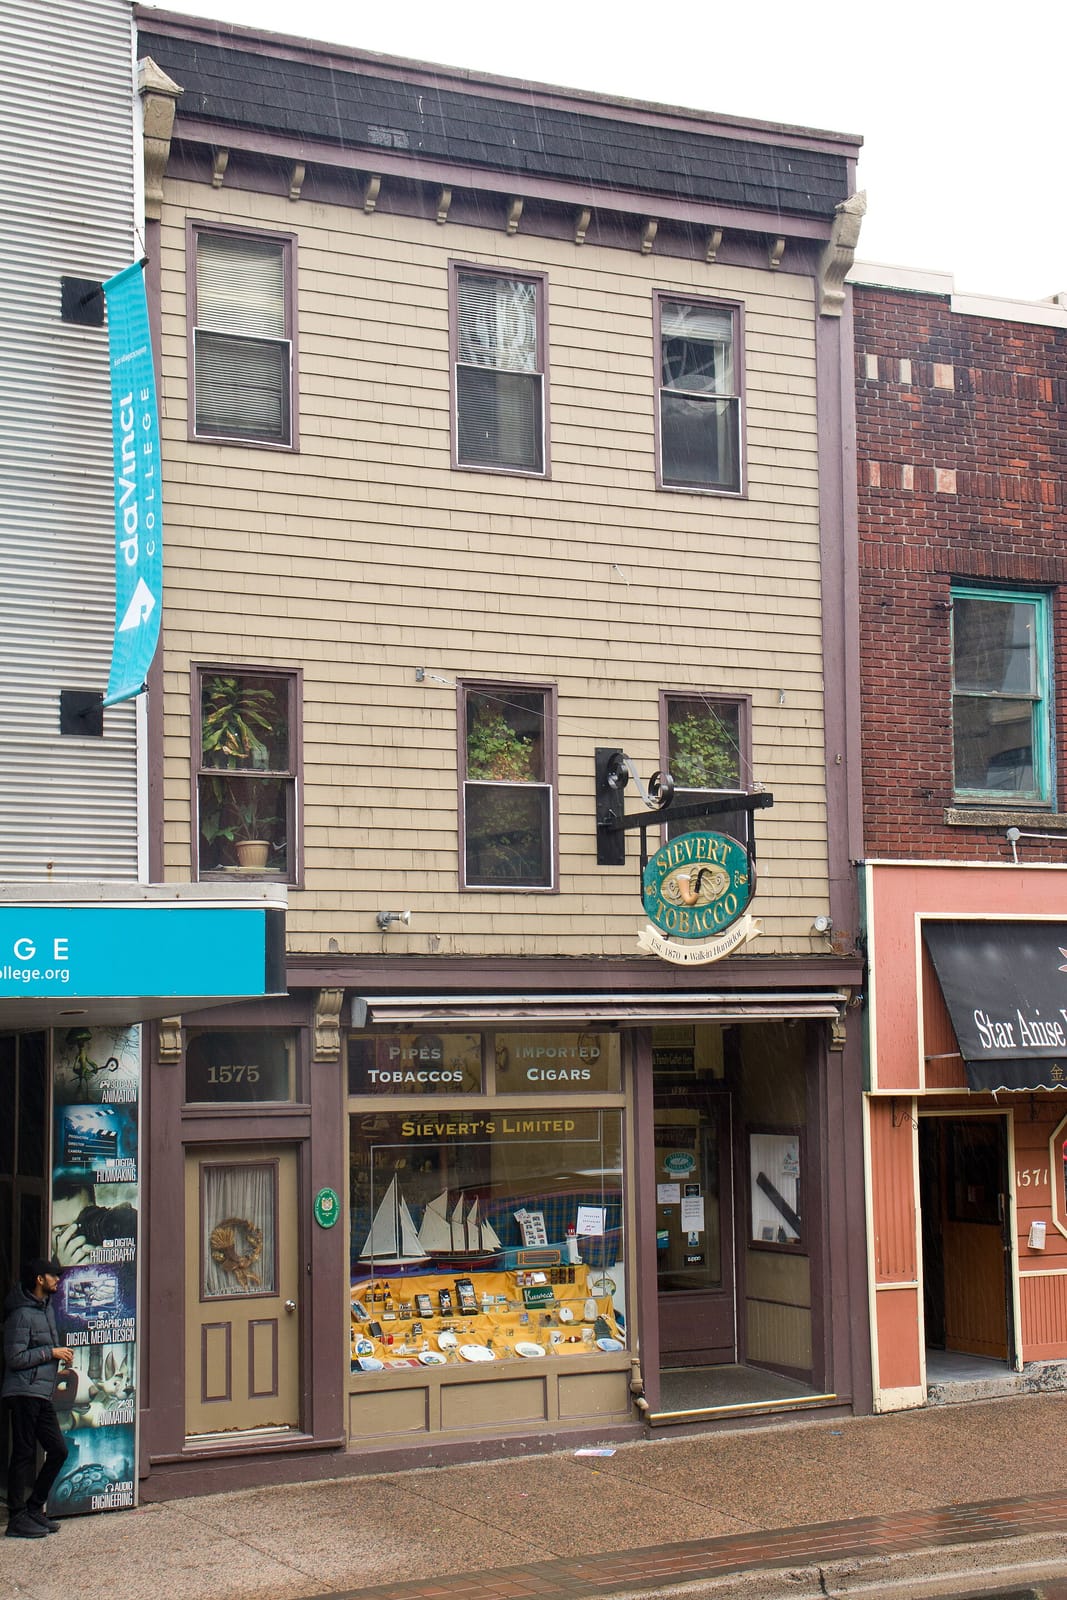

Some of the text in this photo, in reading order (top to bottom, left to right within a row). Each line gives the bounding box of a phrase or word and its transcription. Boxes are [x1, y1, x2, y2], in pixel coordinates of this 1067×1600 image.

[140, 387, 156, 557] COLLEGE
[656, 837, 732, 876] SIEVERT
[654, 893, 738, 933] TOBACCO
[0, 965, 70, 983] llege.org
[974, 1008, 1066, 1049] Star Anise
[515, 1047, 600, 1058] IMPORTED
[207, 1064, 260, 1084] 1575
[368, 1069, 463, 1084] TOBACCOS
[526, 1068, 592, 1081] CIGARS
[1050, 1063, 1064, 1080] 金
[102, 1088, 136, 1103] ANIMATION
[502, 1118, 576, 1134] LIMITED
[115, 1158, 136, 1167] DIGITAL
[96, 1167, 136, 1182] FILMMAKING
[1016, 1169, 1048, 1187] 1571
[114, 1238, 136, 1248] DIGITAL
[90, 1248, 136, 1263] PHOTOGRAPHY
[96, 1318, 135, 1328] GRAPHIC AND
[66, 1327, 135, 1346] DIGITAL MEDIA DESIGN
[126, 1400, 134, 1408] 3D
[98, 1410, 133, 1425] ANIMATION
[114, 1480, 133, 1492] AUDIO
[92, 1492, 133, 1509] ENGINEERING
